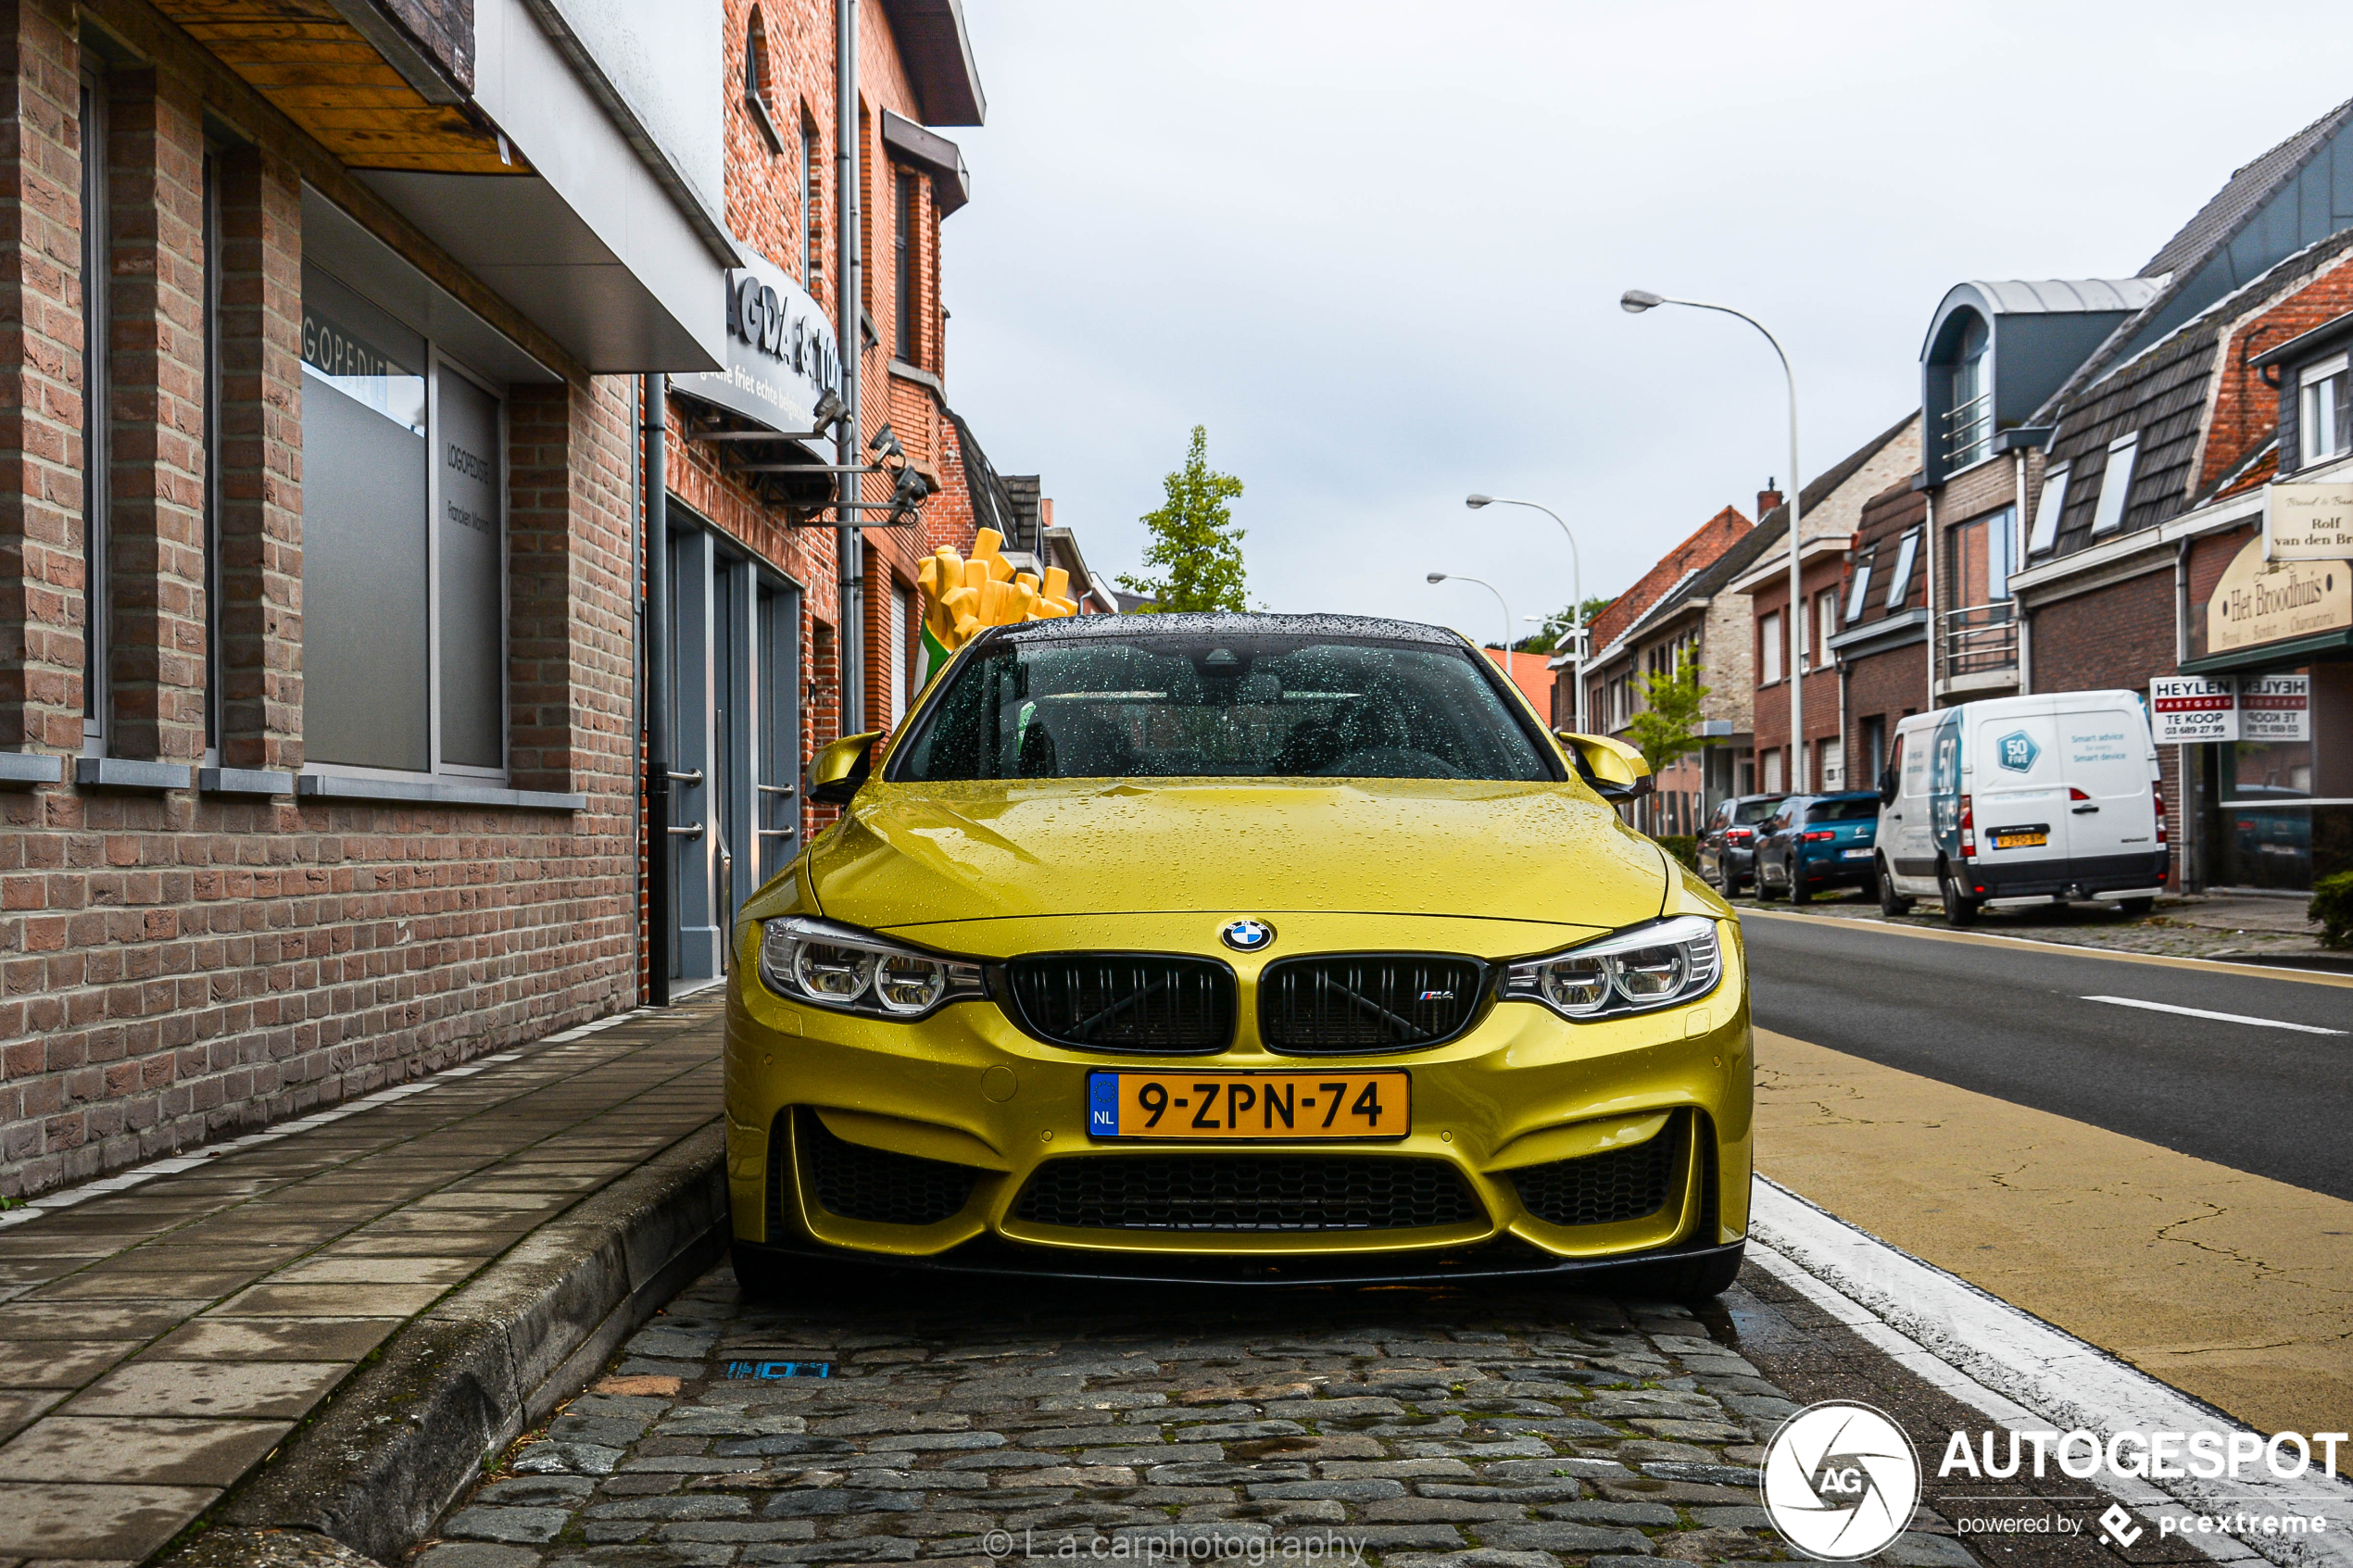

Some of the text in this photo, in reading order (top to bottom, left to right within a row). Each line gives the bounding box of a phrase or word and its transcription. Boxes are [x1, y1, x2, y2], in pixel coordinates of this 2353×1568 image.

[734, 363, 755, 395] friet
[755, 378, 777, 407] echte
[2311, 516, 2342, 530] Rolf
[2274, 537, 2300, 546] van
[2304, 533, 2331, 546] den
[2231, 571, 2322, 622] Het Broodhuis
[2157, 681, 2231, 696] HEYLEN
[2157, 699, 2232, 709] VASTGOED
[2166, 712, 2223, 724] TE KOOP
[2199, 725, 2210, 734] 27
[2212, 724, 2225, 734] 99
[2071, 733, 2124, 744] Smart advice
[2006, 739, 2028, 756] 50
[2007, 755, 2029, 765] FIVE
[2073, 753, 2126, 763] Smart device
[1227, 920, 1268, 931] BMW
[1138, 1081, 1383, 1129] 9-ZPN-74
[1093, 1110, 1114, 1125] NL
